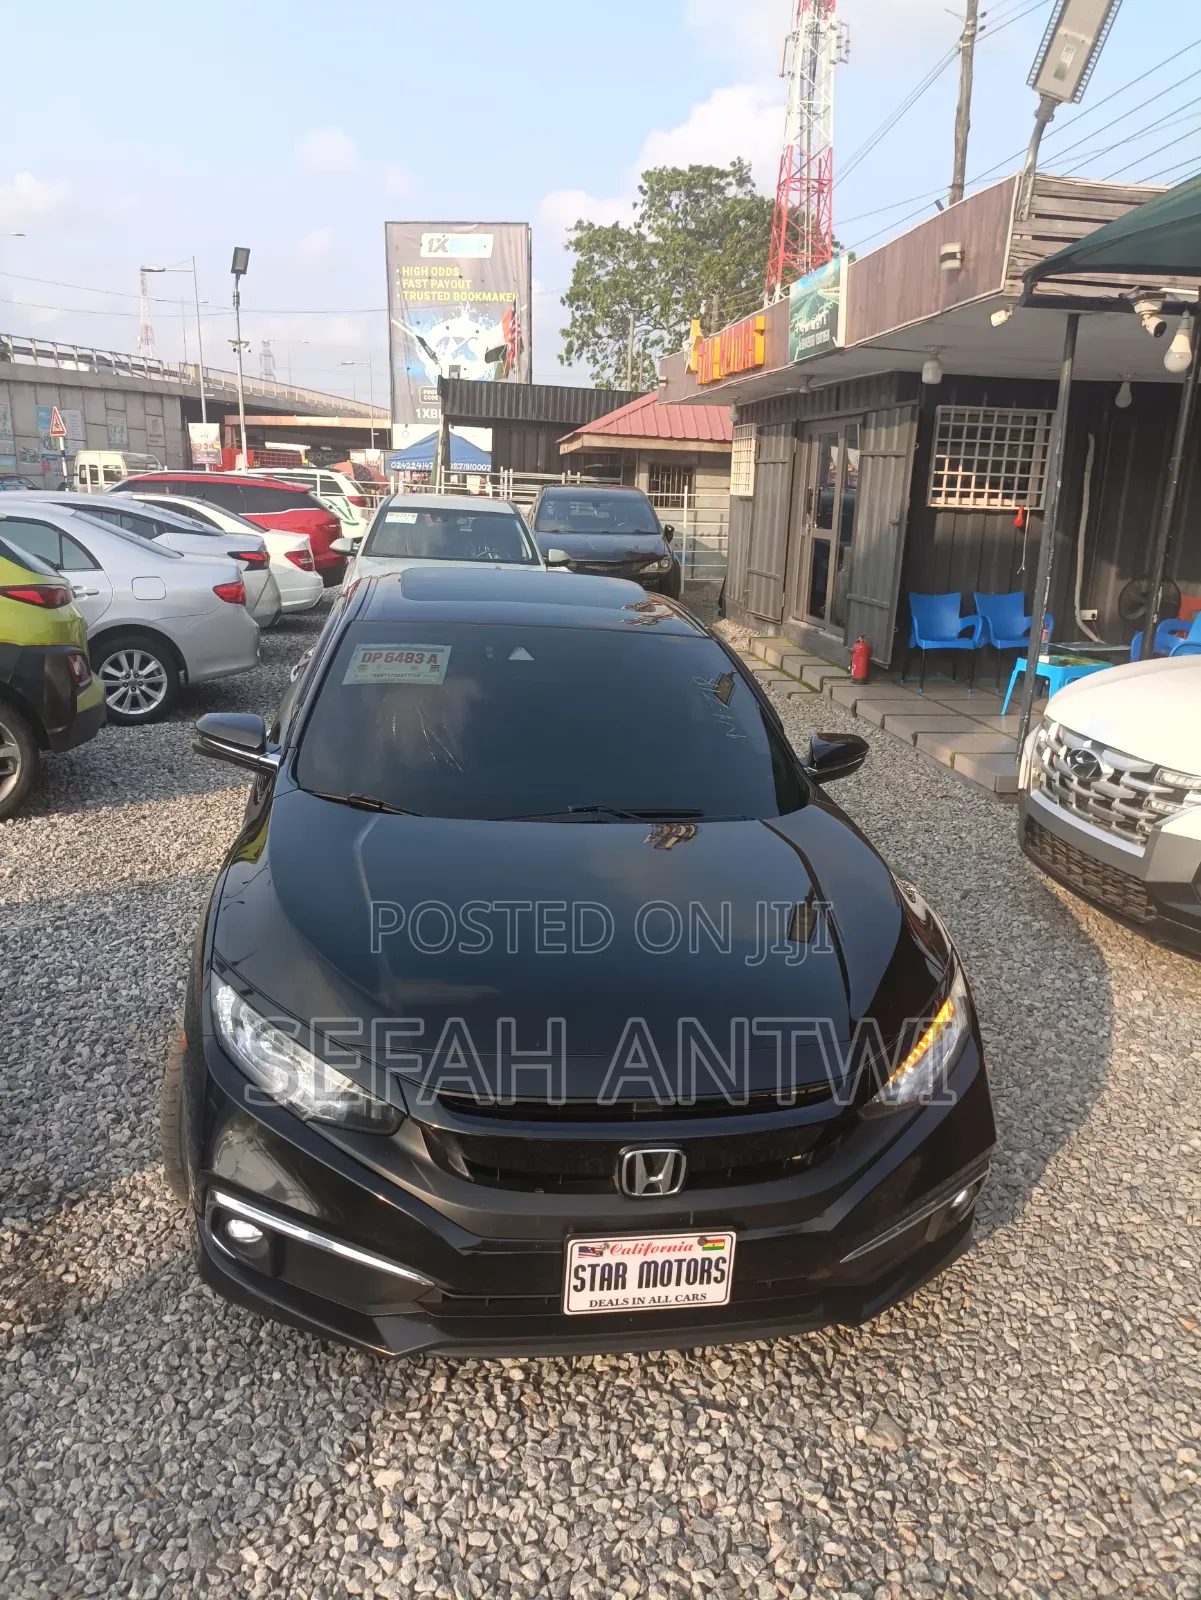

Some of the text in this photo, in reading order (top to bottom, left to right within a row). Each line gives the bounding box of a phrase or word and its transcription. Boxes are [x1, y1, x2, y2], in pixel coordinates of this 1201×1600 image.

[402, 266, 461, 277] HIGH ODDS
[402, 279, 473, 289] FAST PAYOUT
[402, 291, 451, 301] TRUSTED
[361, 652, 438, 665] DP 6483 A
[609, 1241, 694, 1257] California
[572, 1256, 728, 1293] STAR MOTORS
[588, 1292, 708, 1308] DEALS IN ALL CARS
